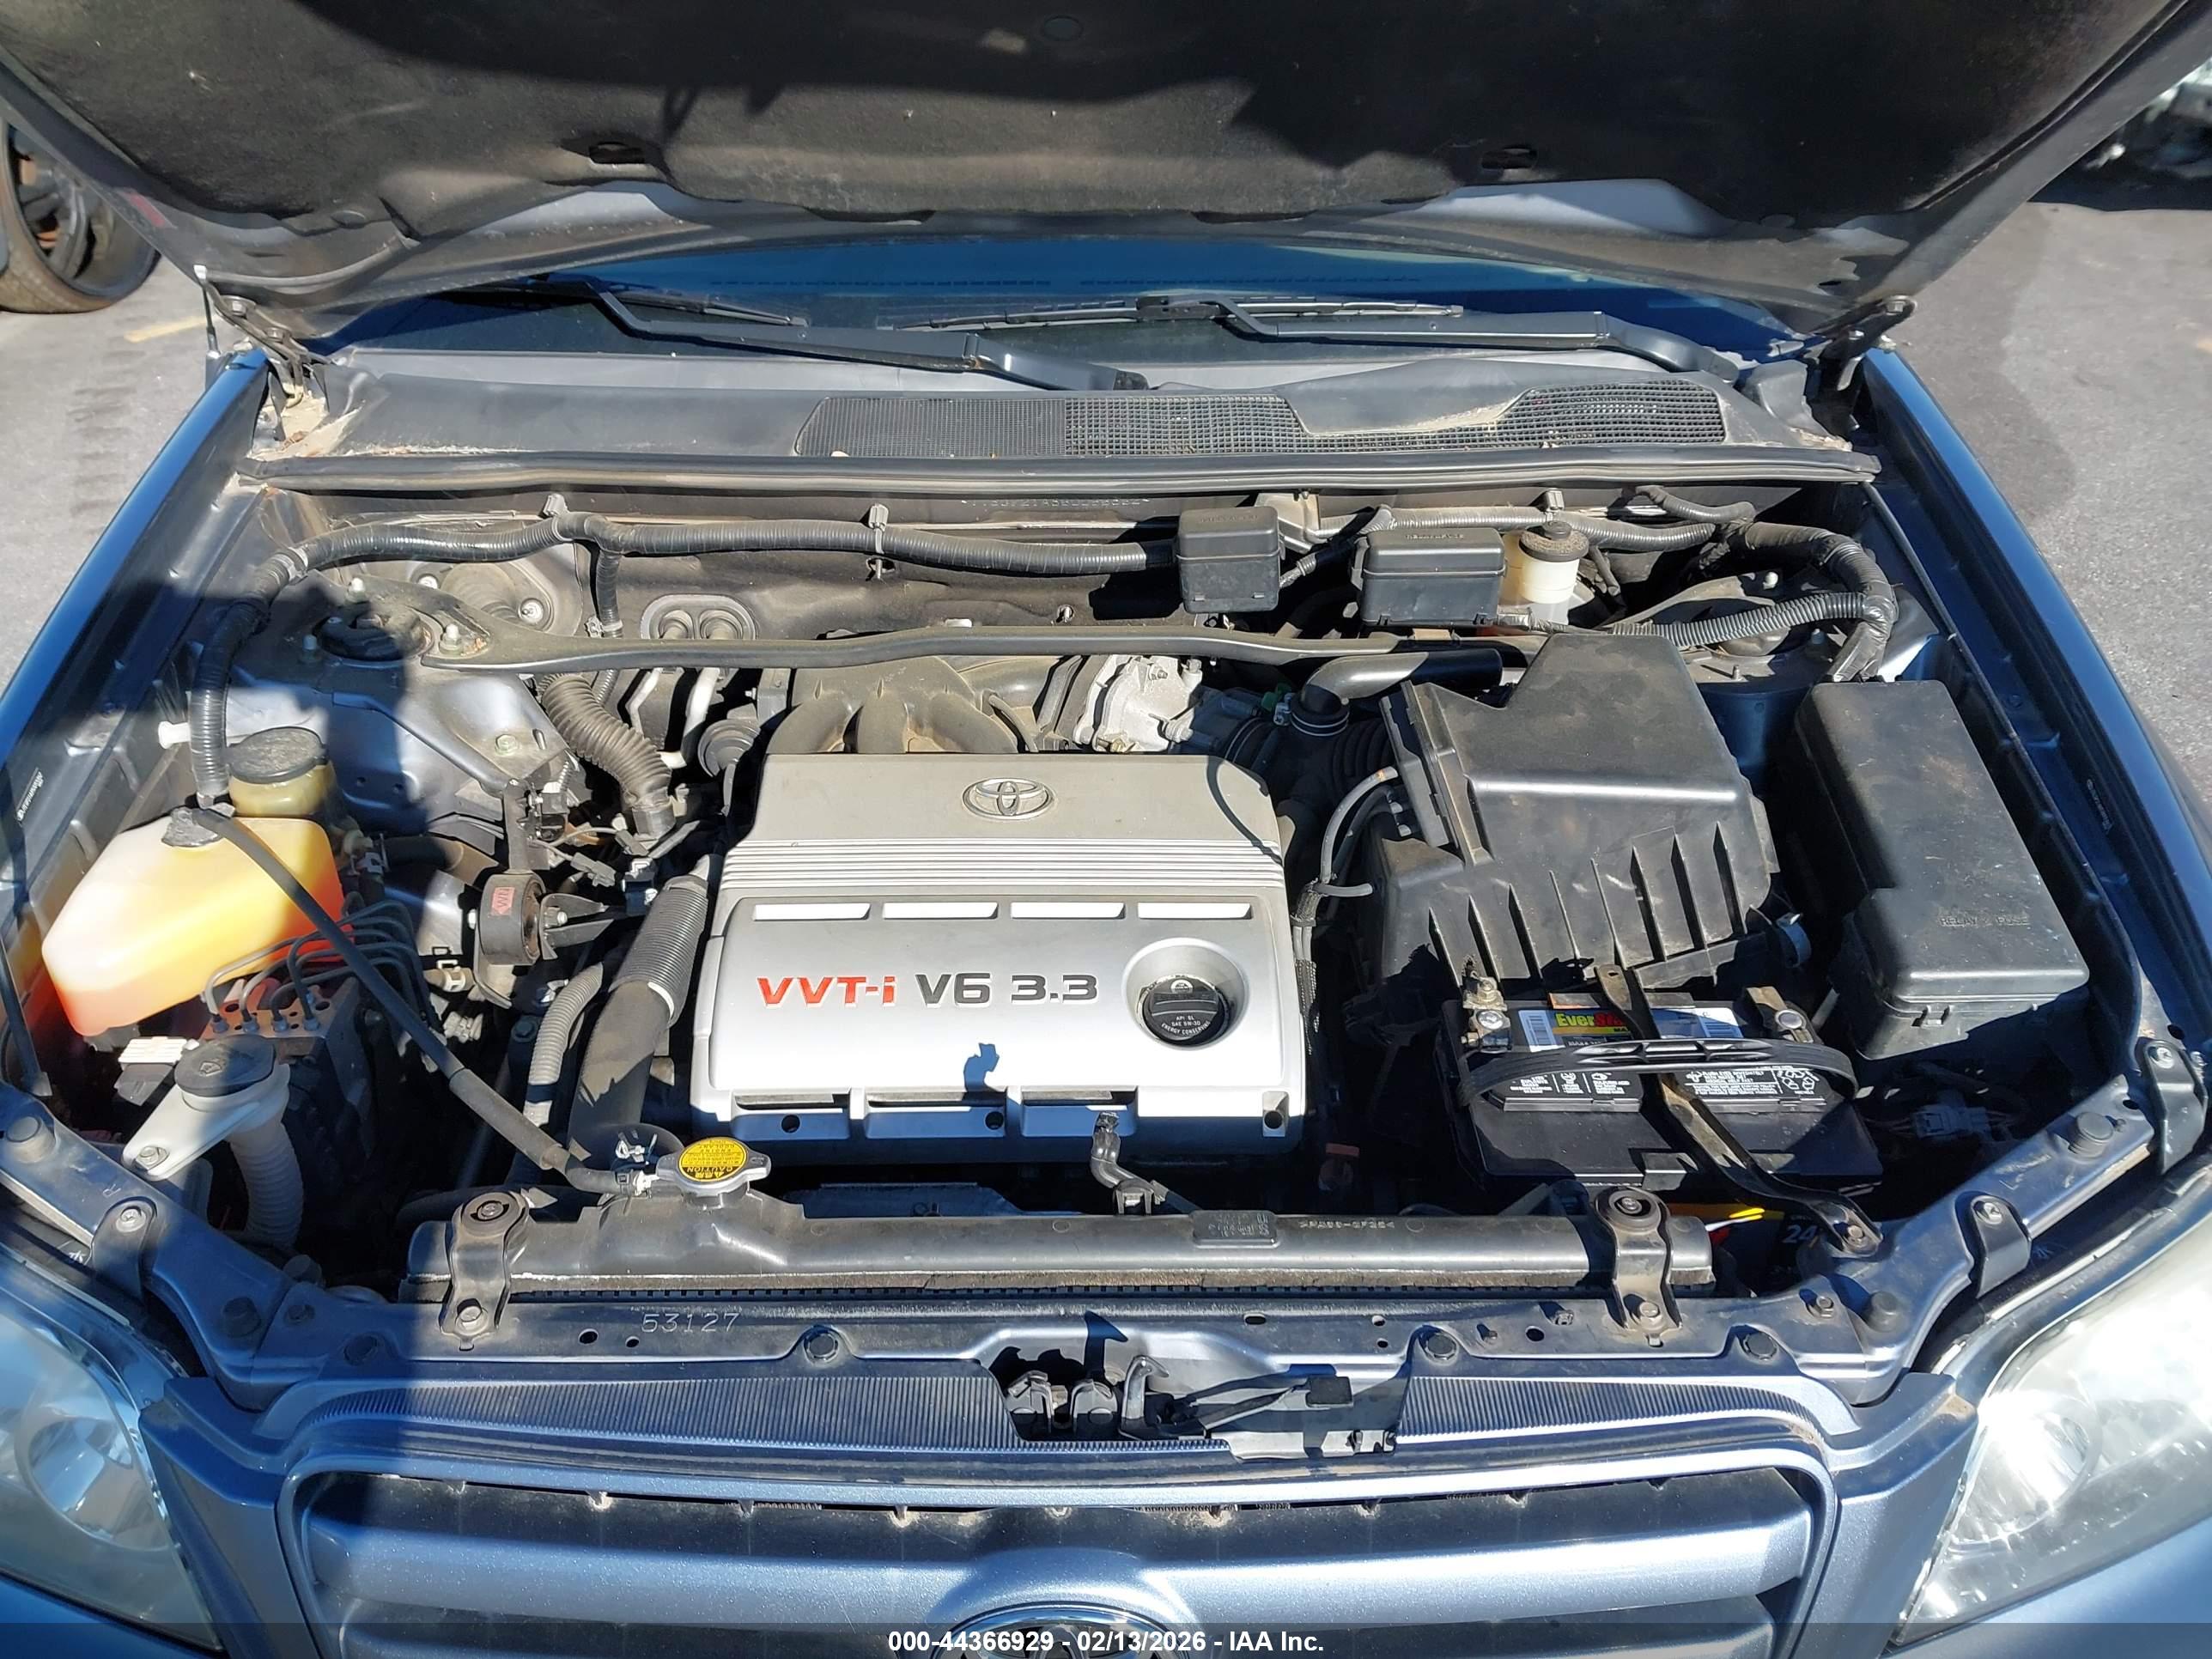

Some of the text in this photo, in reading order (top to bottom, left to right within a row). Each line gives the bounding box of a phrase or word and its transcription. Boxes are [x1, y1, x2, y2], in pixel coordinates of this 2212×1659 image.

[757, 973, 1097, 1006] VVT-i V6 3.3
[1161, 1020, 1211, 1036] ENERGY CONSERVING
[1555, 1013, 1624, 1027] EverSta
[641, 1312, 739, 1333] 53127
